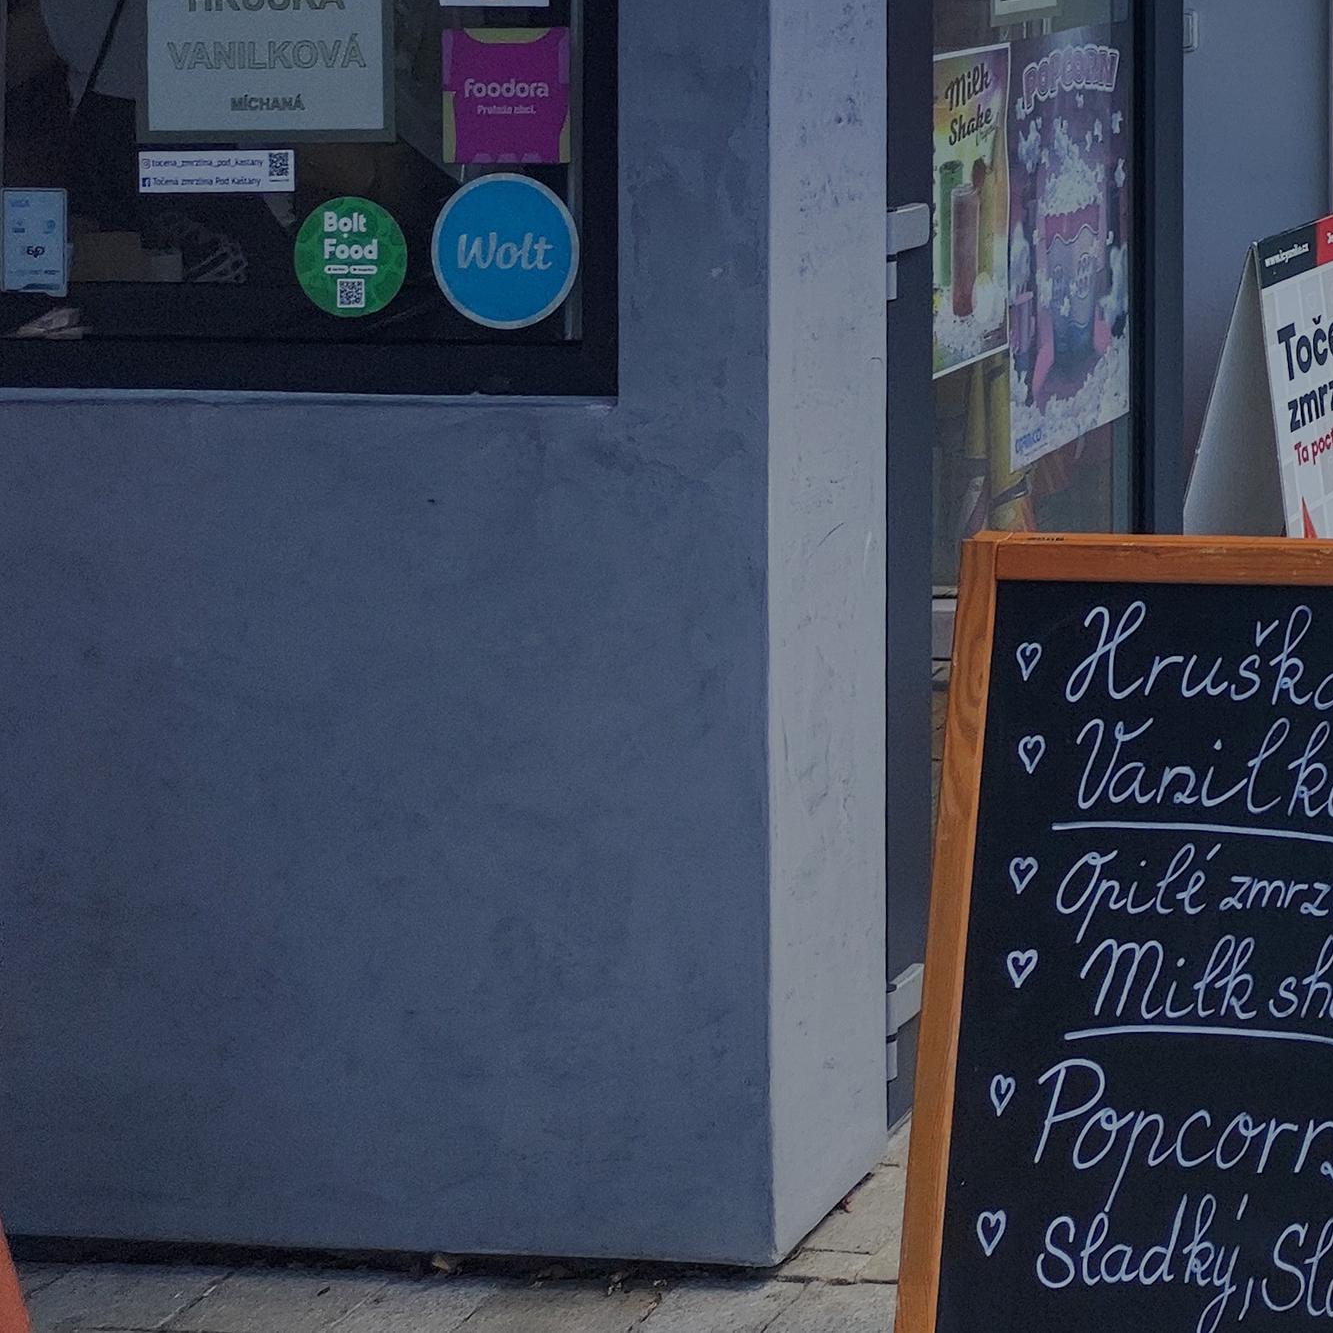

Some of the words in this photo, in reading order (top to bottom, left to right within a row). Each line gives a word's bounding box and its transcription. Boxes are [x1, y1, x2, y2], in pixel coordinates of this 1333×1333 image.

[167, 32, 367, 70] VANILKOVÁ
[463, 78, 549, 98] foodora
[945, 62, 992, 111] Milk
[1022, 45, 1120, 115] POPCORN
[230, 93, 306, 111] MÍCHANÁ
[949, 104, 992, 147] Shake
[323, 211, 367, 234] Bolt
[323, 238, 378, 261] Food
[457, 232, 554, 271] Wolt
[1293, 441, 1309, 465] Ta
[1056, 841, 1222, 945] Opilé
